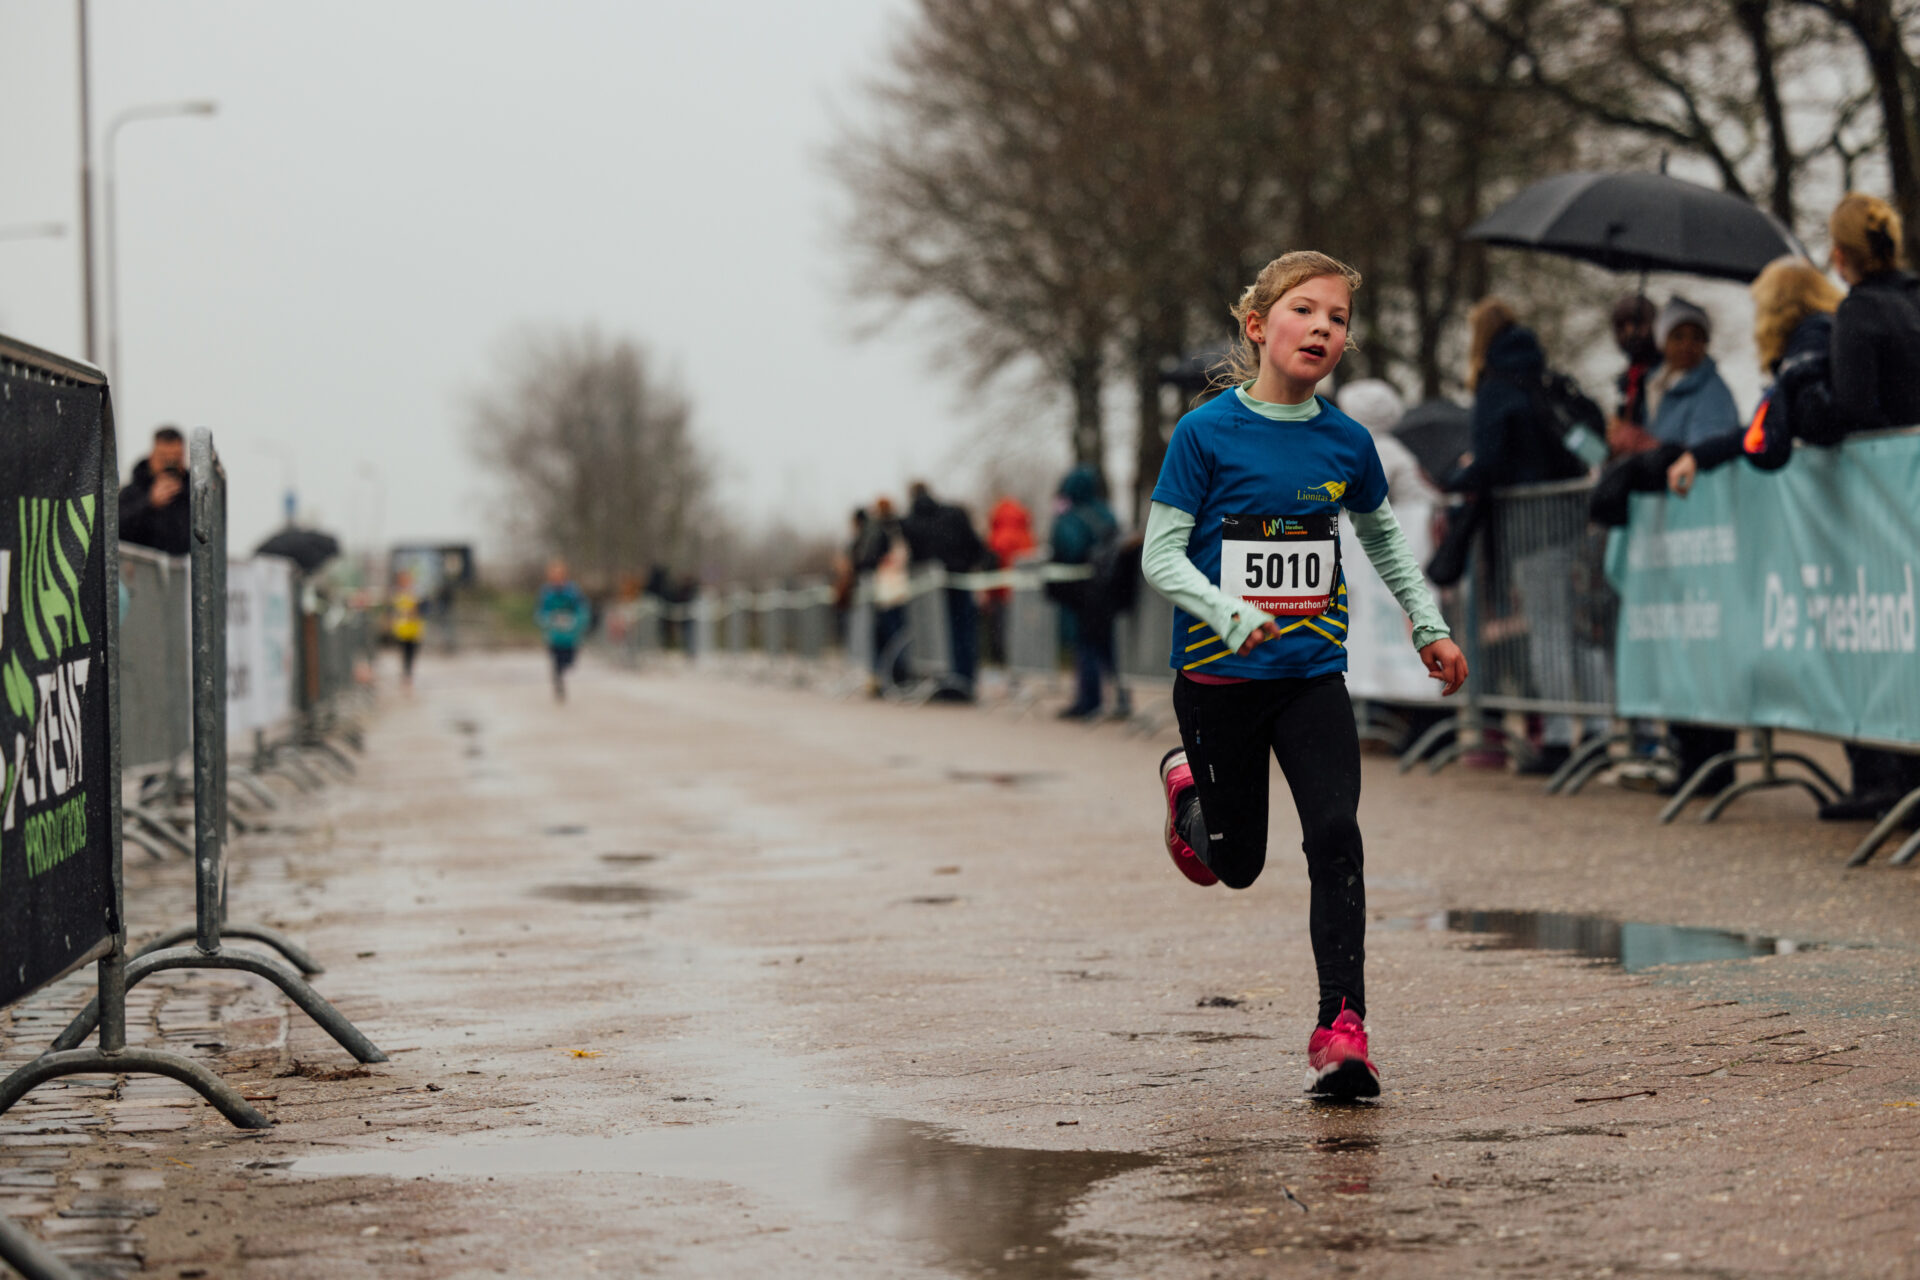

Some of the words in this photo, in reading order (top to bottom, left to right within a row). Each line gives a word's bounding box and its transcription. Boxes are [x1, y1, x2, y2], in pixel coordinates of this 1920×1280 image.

[1297, 489, 1329, 502] Lionitas
[1245, 552, 1320, 589] 5010
[1763, 571, 1798, 650] De
[24, 791, 87, 880] PRODUCTIONS
